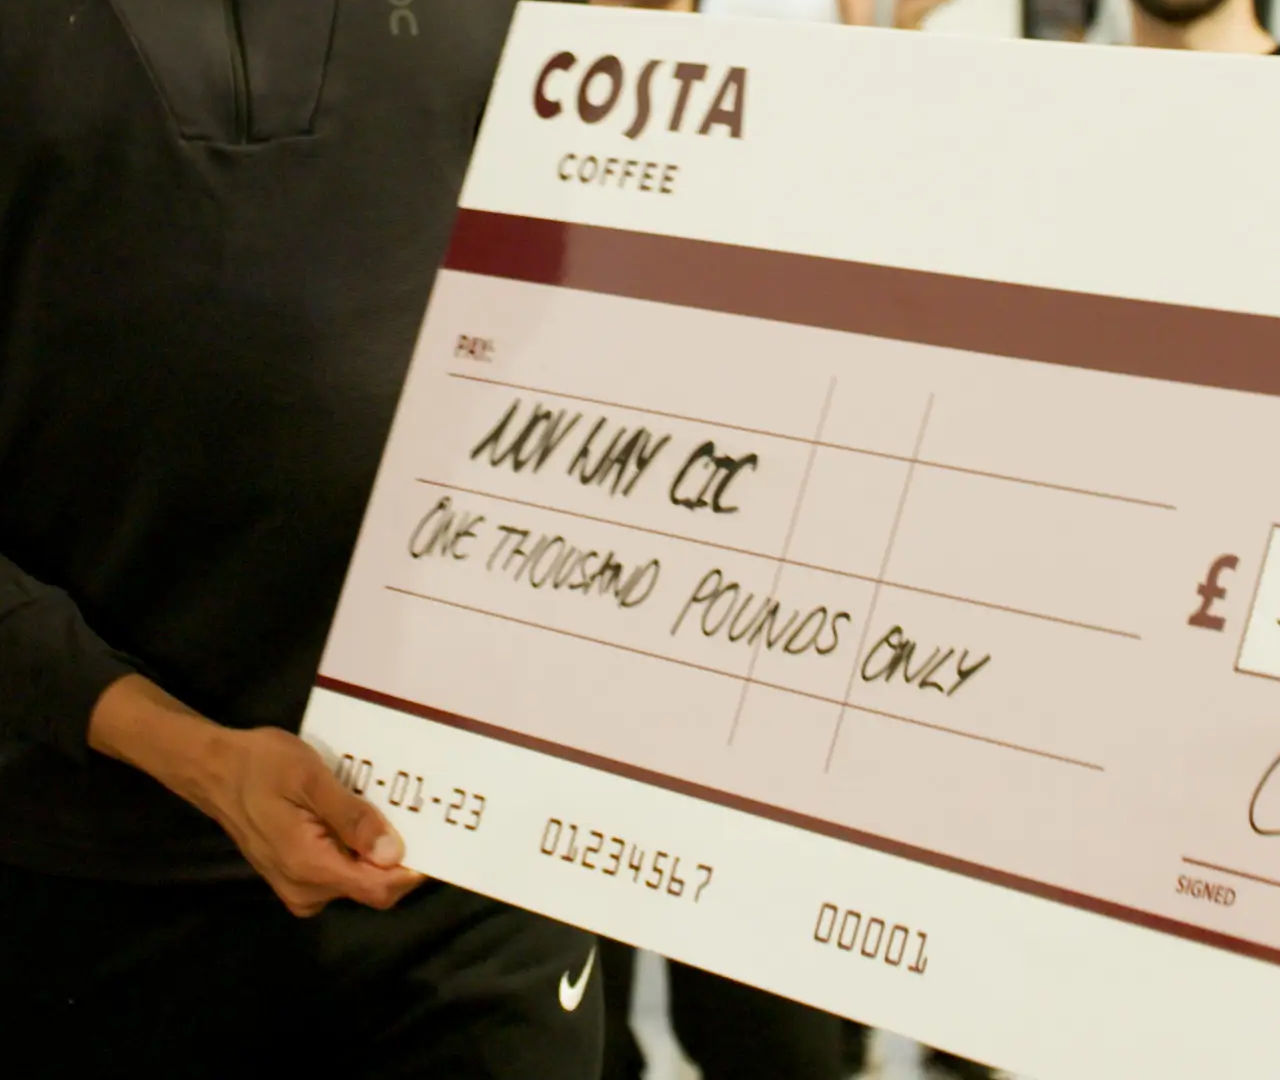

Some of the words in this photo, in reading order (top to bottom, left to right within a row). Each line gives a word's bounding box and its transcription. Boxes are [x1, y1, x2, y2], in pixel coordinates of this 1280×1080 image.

[533, 51, 749, 140] COSTA
[557, 153, 679, 194] COFFEE
[566, 416, 672, 497] WAY
[669, 440, 758, 513] CIC
[409, 496, 485, 560] ONE
[486, 525, 660, 608] THOUSAND
[671, 568, 851, 655] POUNDS
[860, 625, 991, 696] ONLY
[539, 817, 713, 903] 01234567
[813, 902, 928, 975] 00001
[1175, 875, 1237, 907] SIGNED
